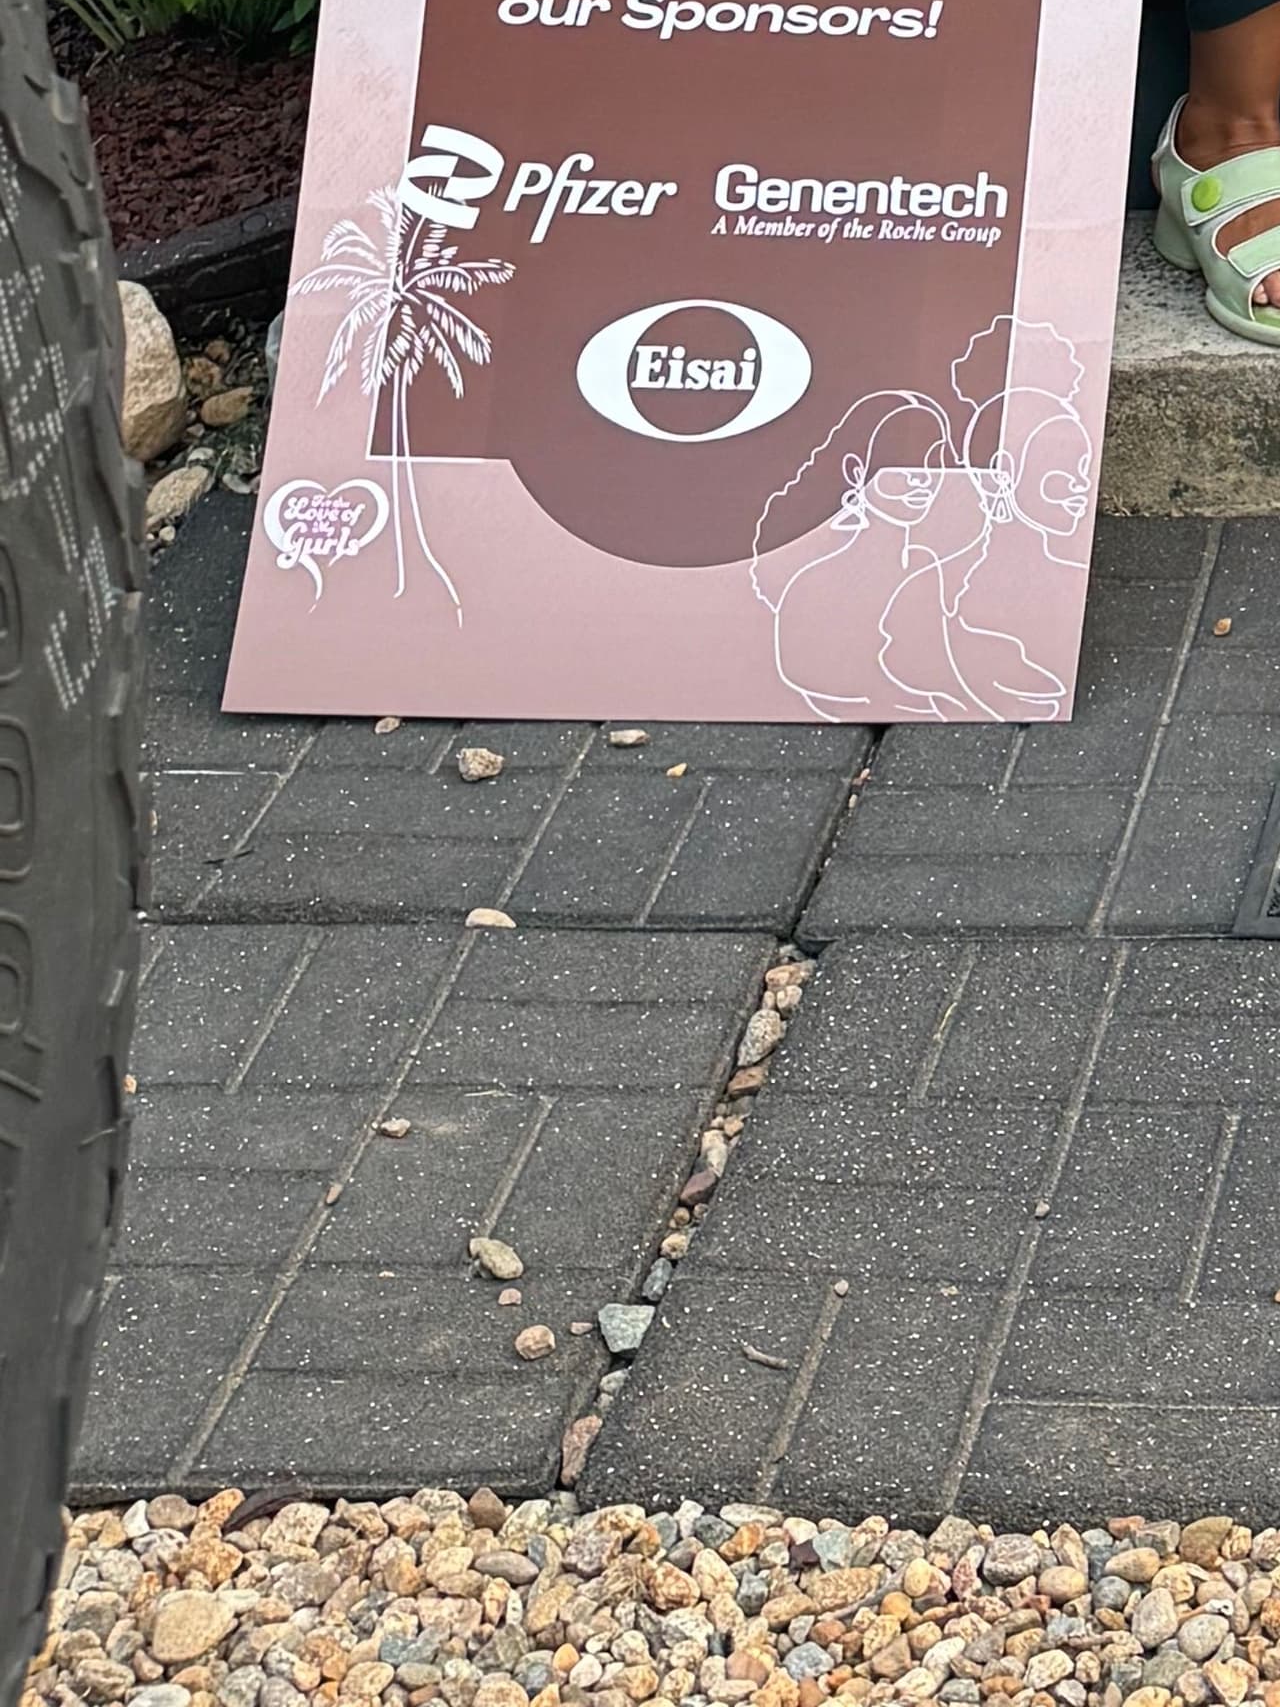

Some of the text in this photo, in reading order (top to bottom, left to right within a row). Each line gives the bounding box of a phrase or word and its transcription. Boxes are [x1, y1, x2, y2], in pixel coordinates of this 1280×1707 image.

[503, 153, 1009, 244] Pfizer Genentech
[711, 217, 1003, 248] A Member of the Roche Group
[631, 345, 759, 391] Eisai
